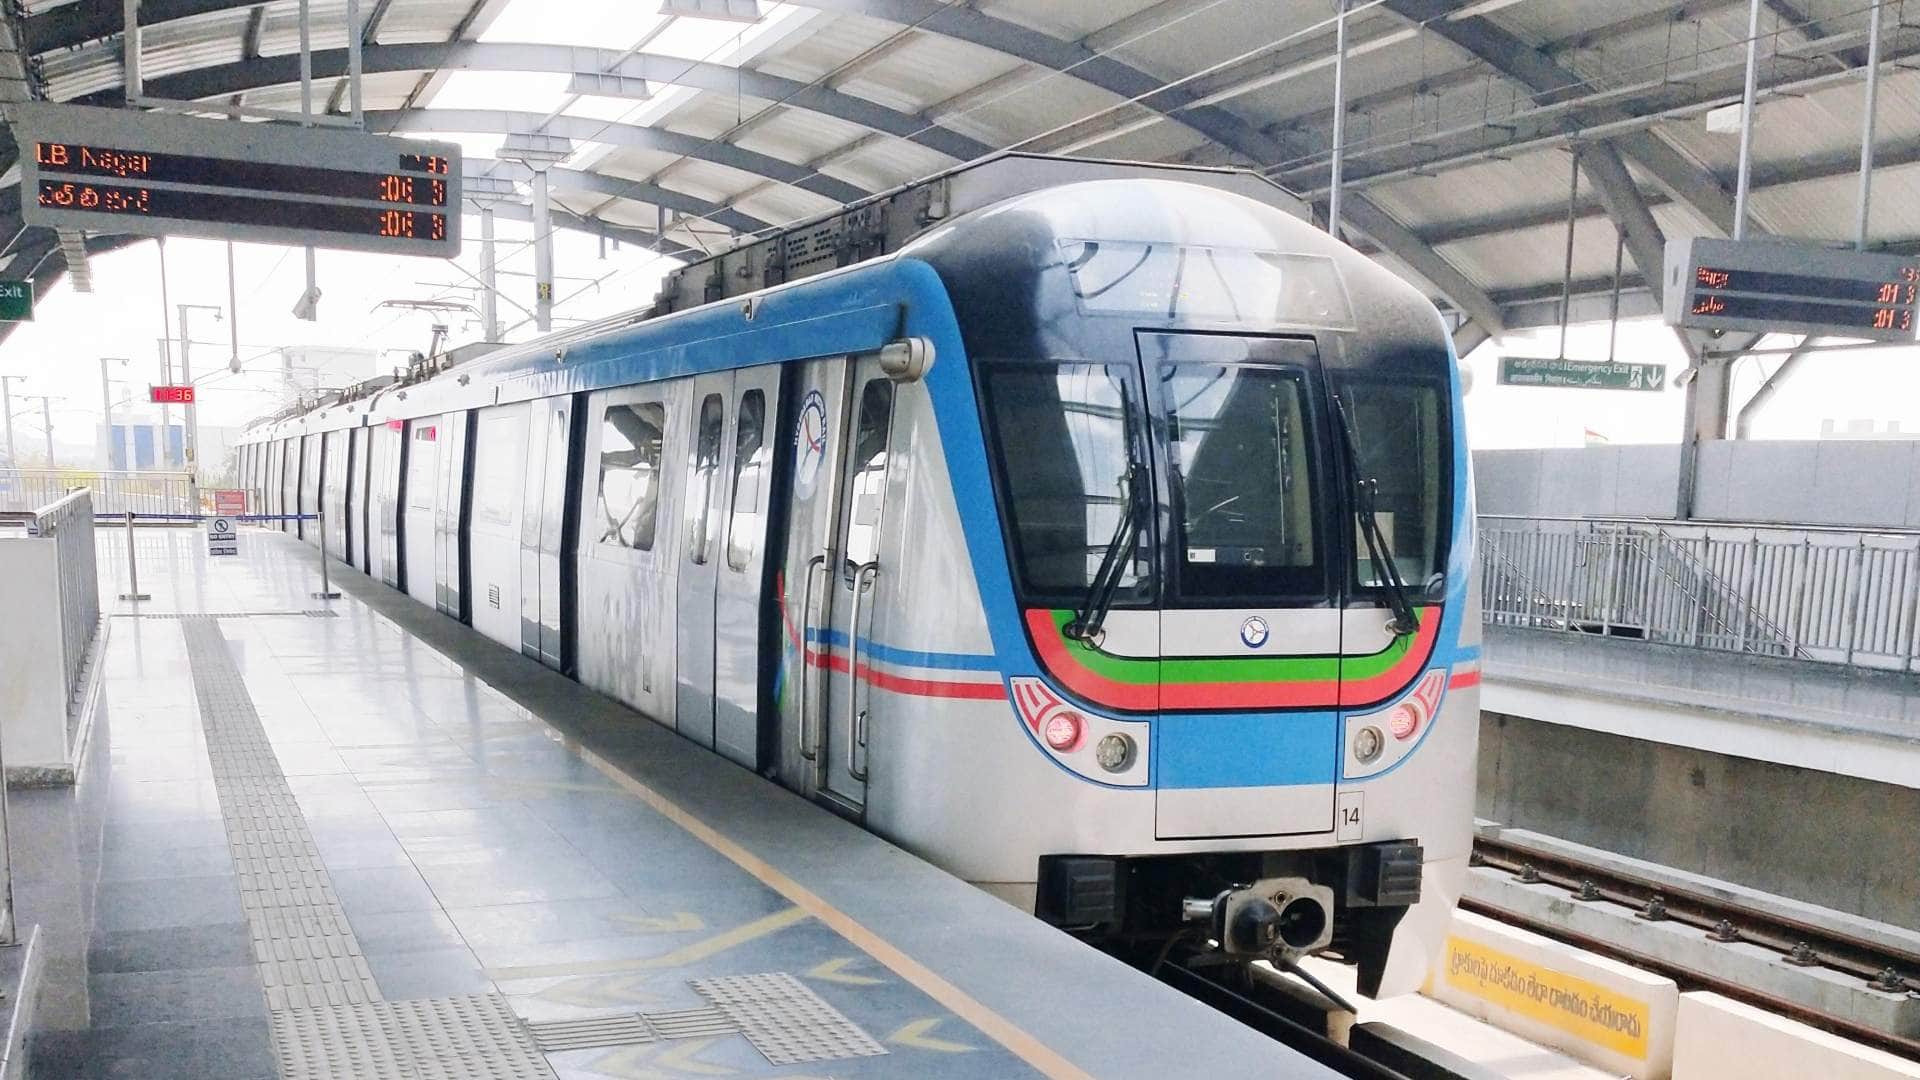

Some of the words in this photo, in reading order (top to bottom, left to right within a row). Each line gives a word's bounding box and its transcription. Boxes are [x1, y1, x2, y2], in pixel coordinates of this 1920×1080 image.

[1568, 363, 1613, 375] Emergency
[1613, 364, 1629, 374] Exit
[1342, 807, 1361, 826] 14
